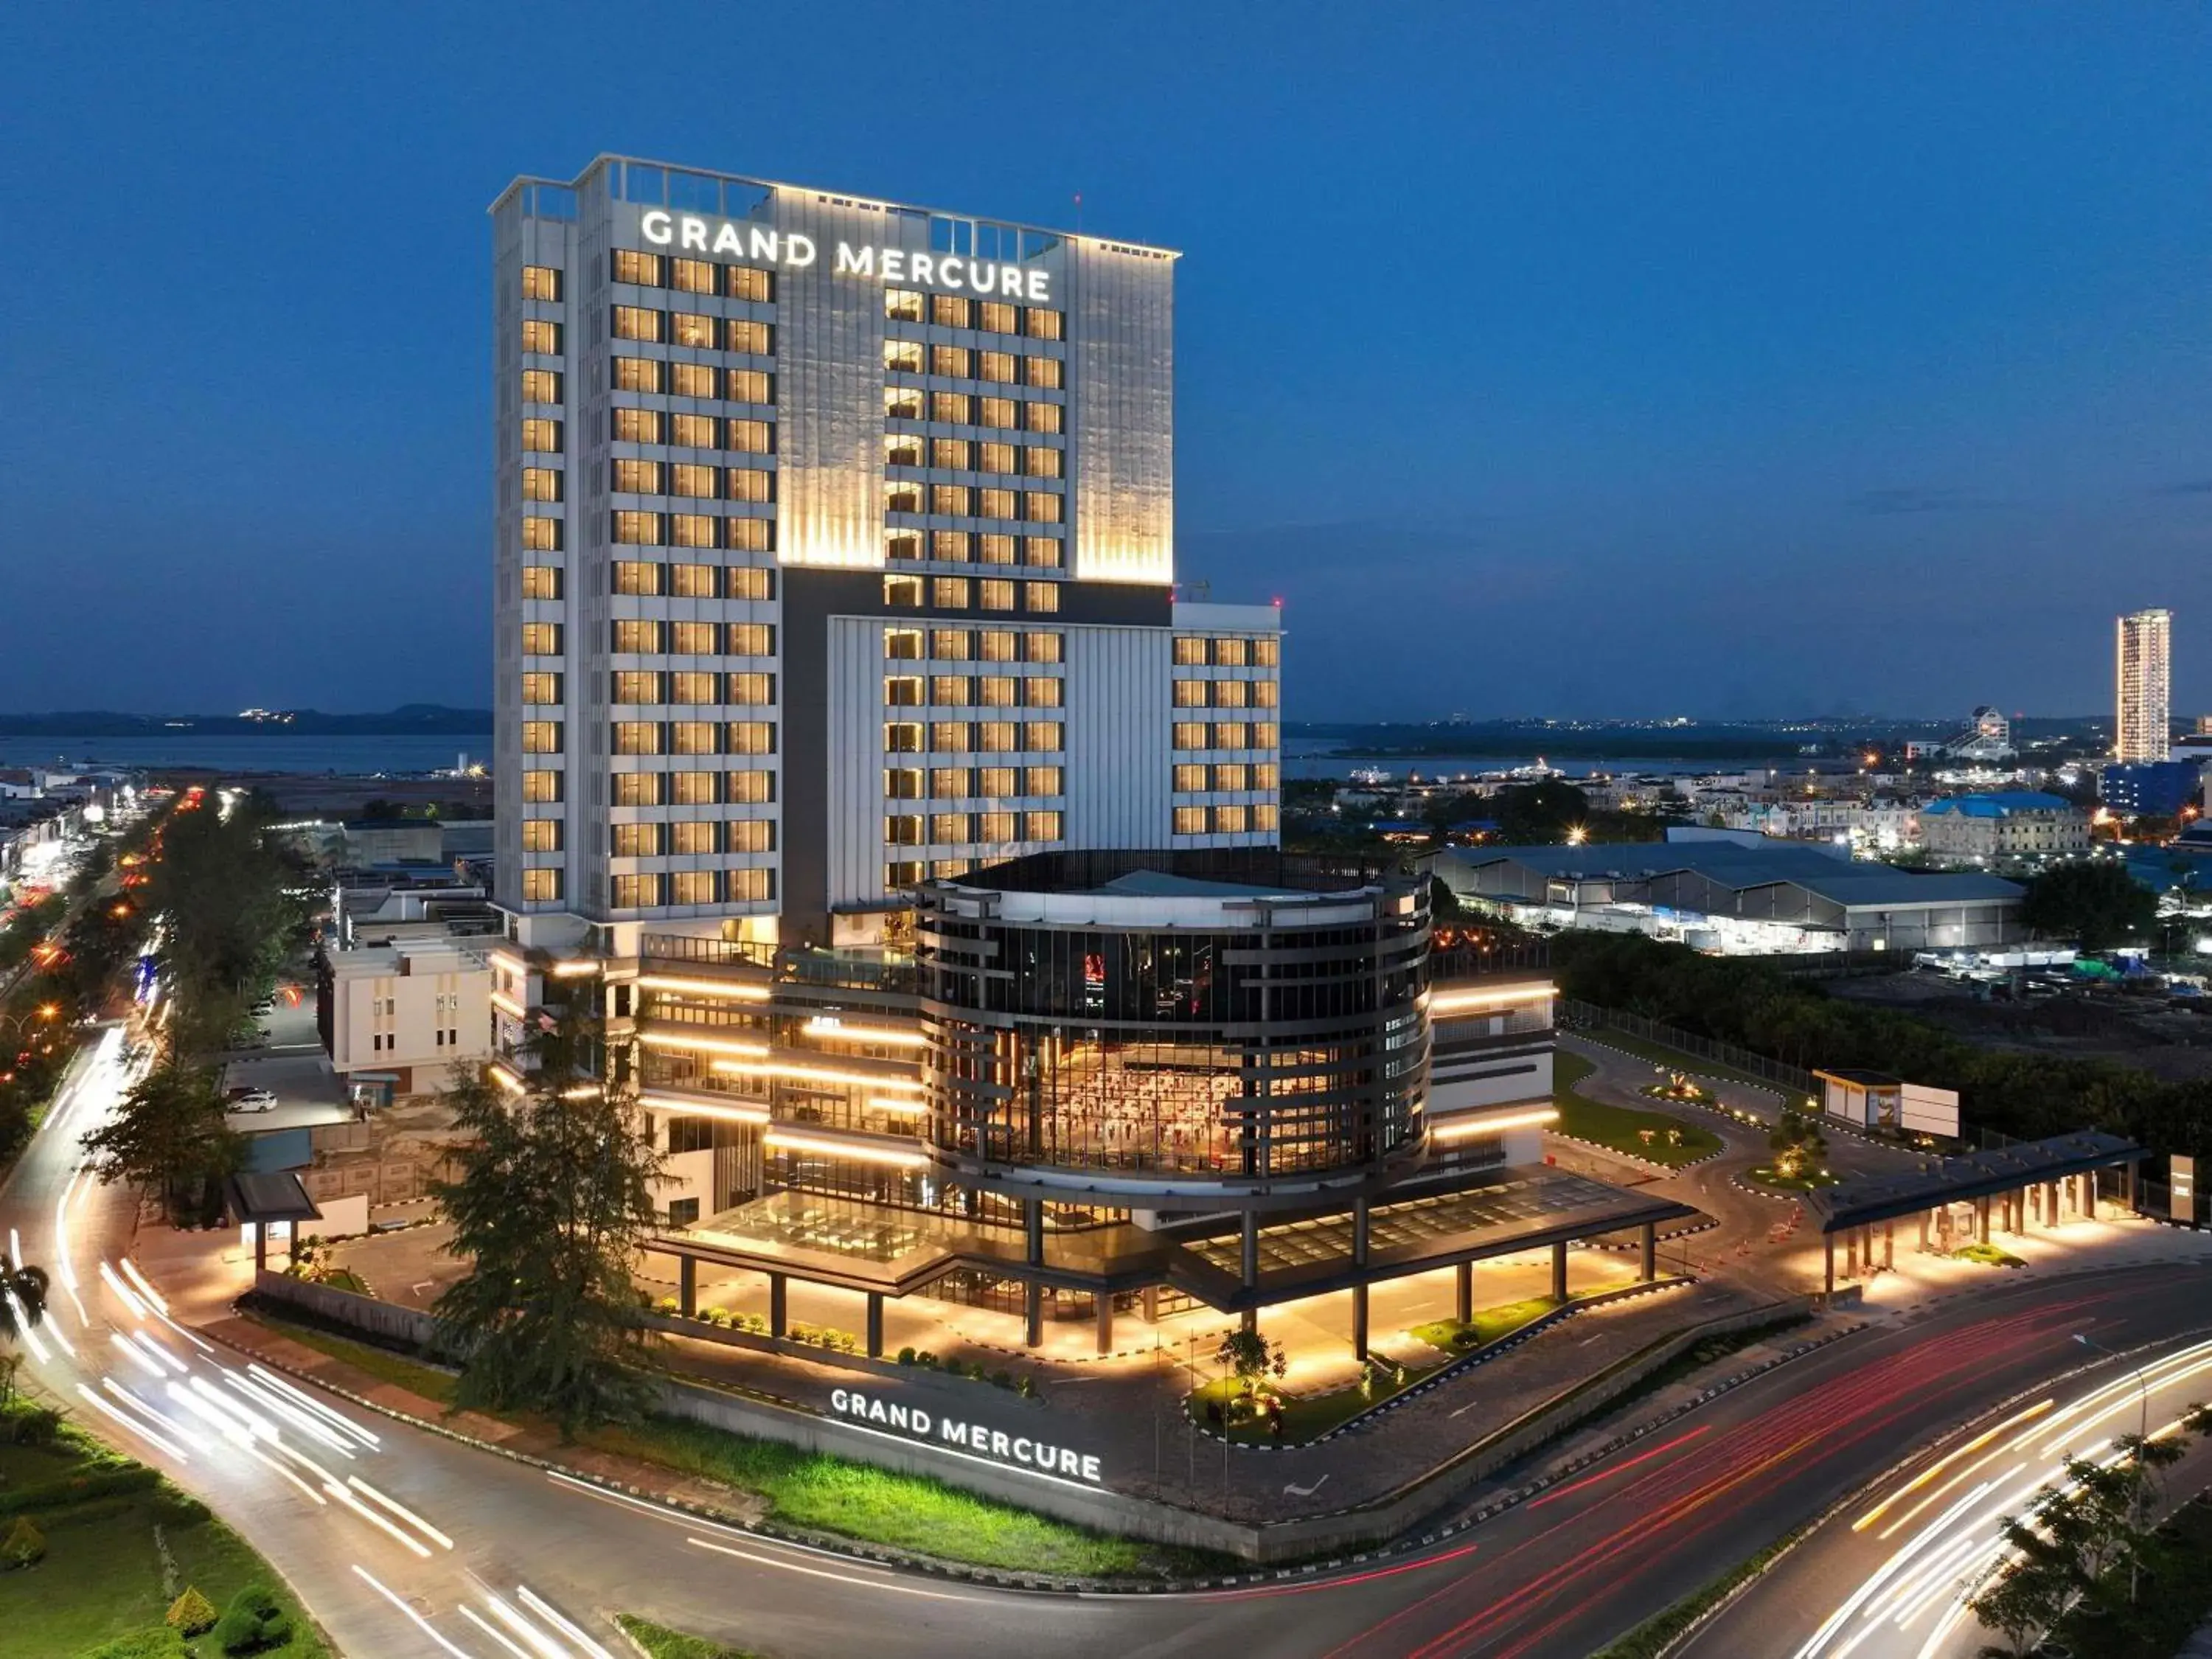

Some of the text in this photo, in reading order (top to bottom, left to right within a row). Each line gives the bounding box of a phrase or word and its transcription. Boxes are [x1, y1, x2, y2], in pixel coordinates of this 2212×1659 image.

[642, 211, 1049, 301] GRAND MERCURE
[831, 1388, 1101, 1481] GRAND MERCURE
